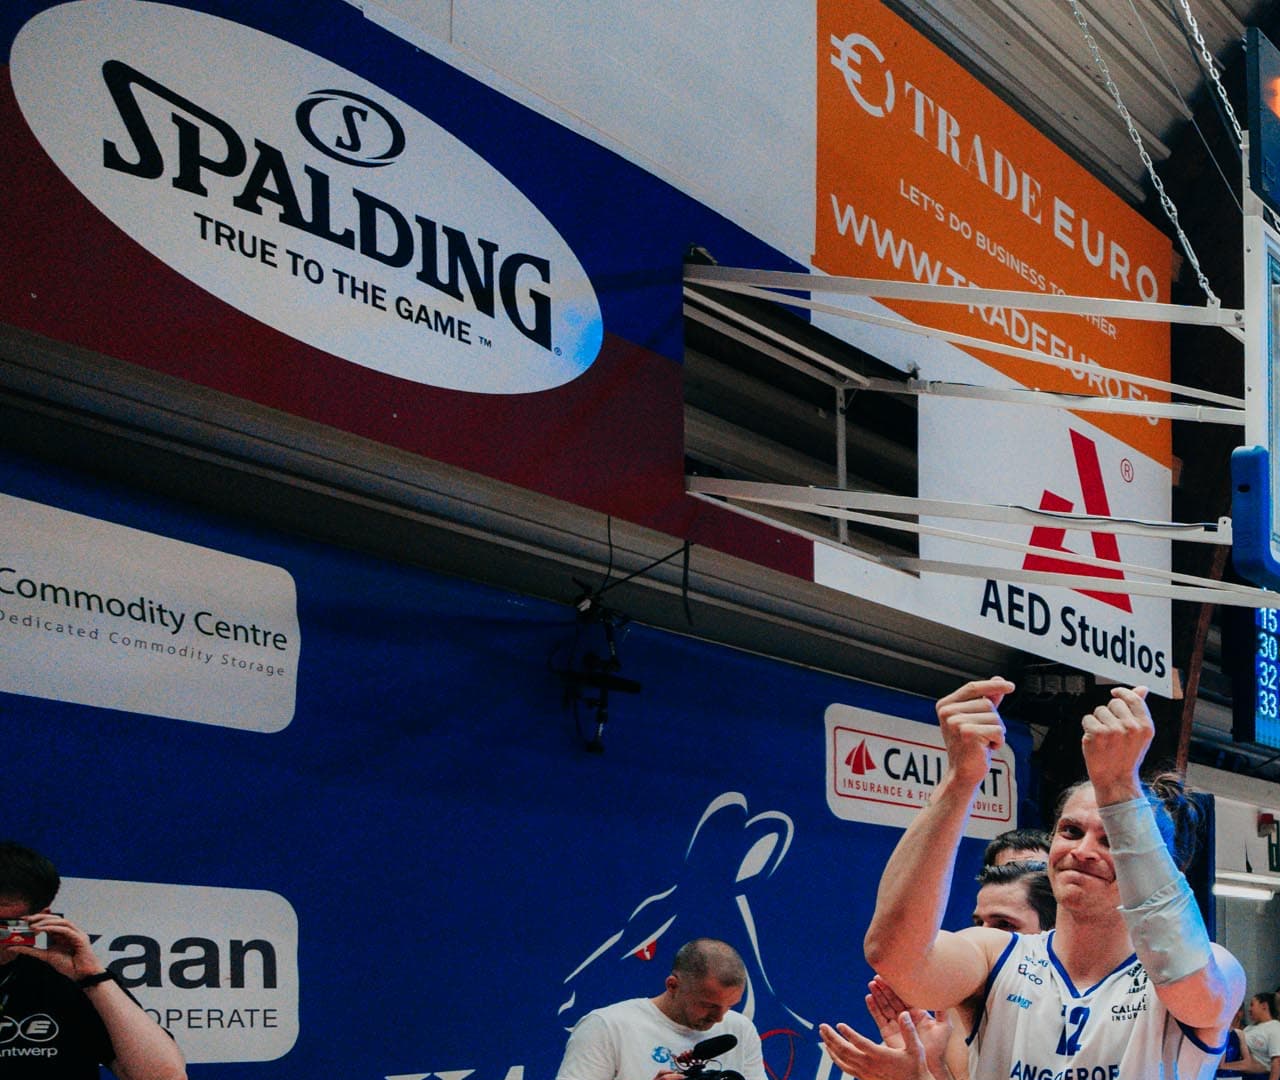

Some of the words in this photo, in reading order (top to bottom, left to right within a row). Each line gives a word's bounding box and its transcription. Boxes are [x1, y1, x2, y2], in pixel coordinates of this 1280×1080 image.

[102, 59, 552, 352] SPALDING
[900, 178, 945, 221] LET'S
[949, 212, 972, 240] DO
[976, 231, 1046, 286] BUSINESS
[904, 81, 1043, 226] TRADE
[1052, 197, 1160, 303] EURO
[194, 211, 278, 268] TRUE
[286, 249, 325, 285] TO
[332, 267, 387, 312] THE
[395, 293, 473, 346] GAME
[0, 568, 186, 634] Commodity
[193, 610, 289, 652] Centre
[980, 578, 1051, 637] AED
[1060, 606, 1167, 679] Studios
[1259, 633, 1278, 658] 30
[109, 631, 214, 664] Commodity
[221, 653, 286, 677] Storage
[1259, 664, 1278, 690] 32
[1260, 692, 1278, 718] 33
[843, 778, 902, 798] INSURANCE
